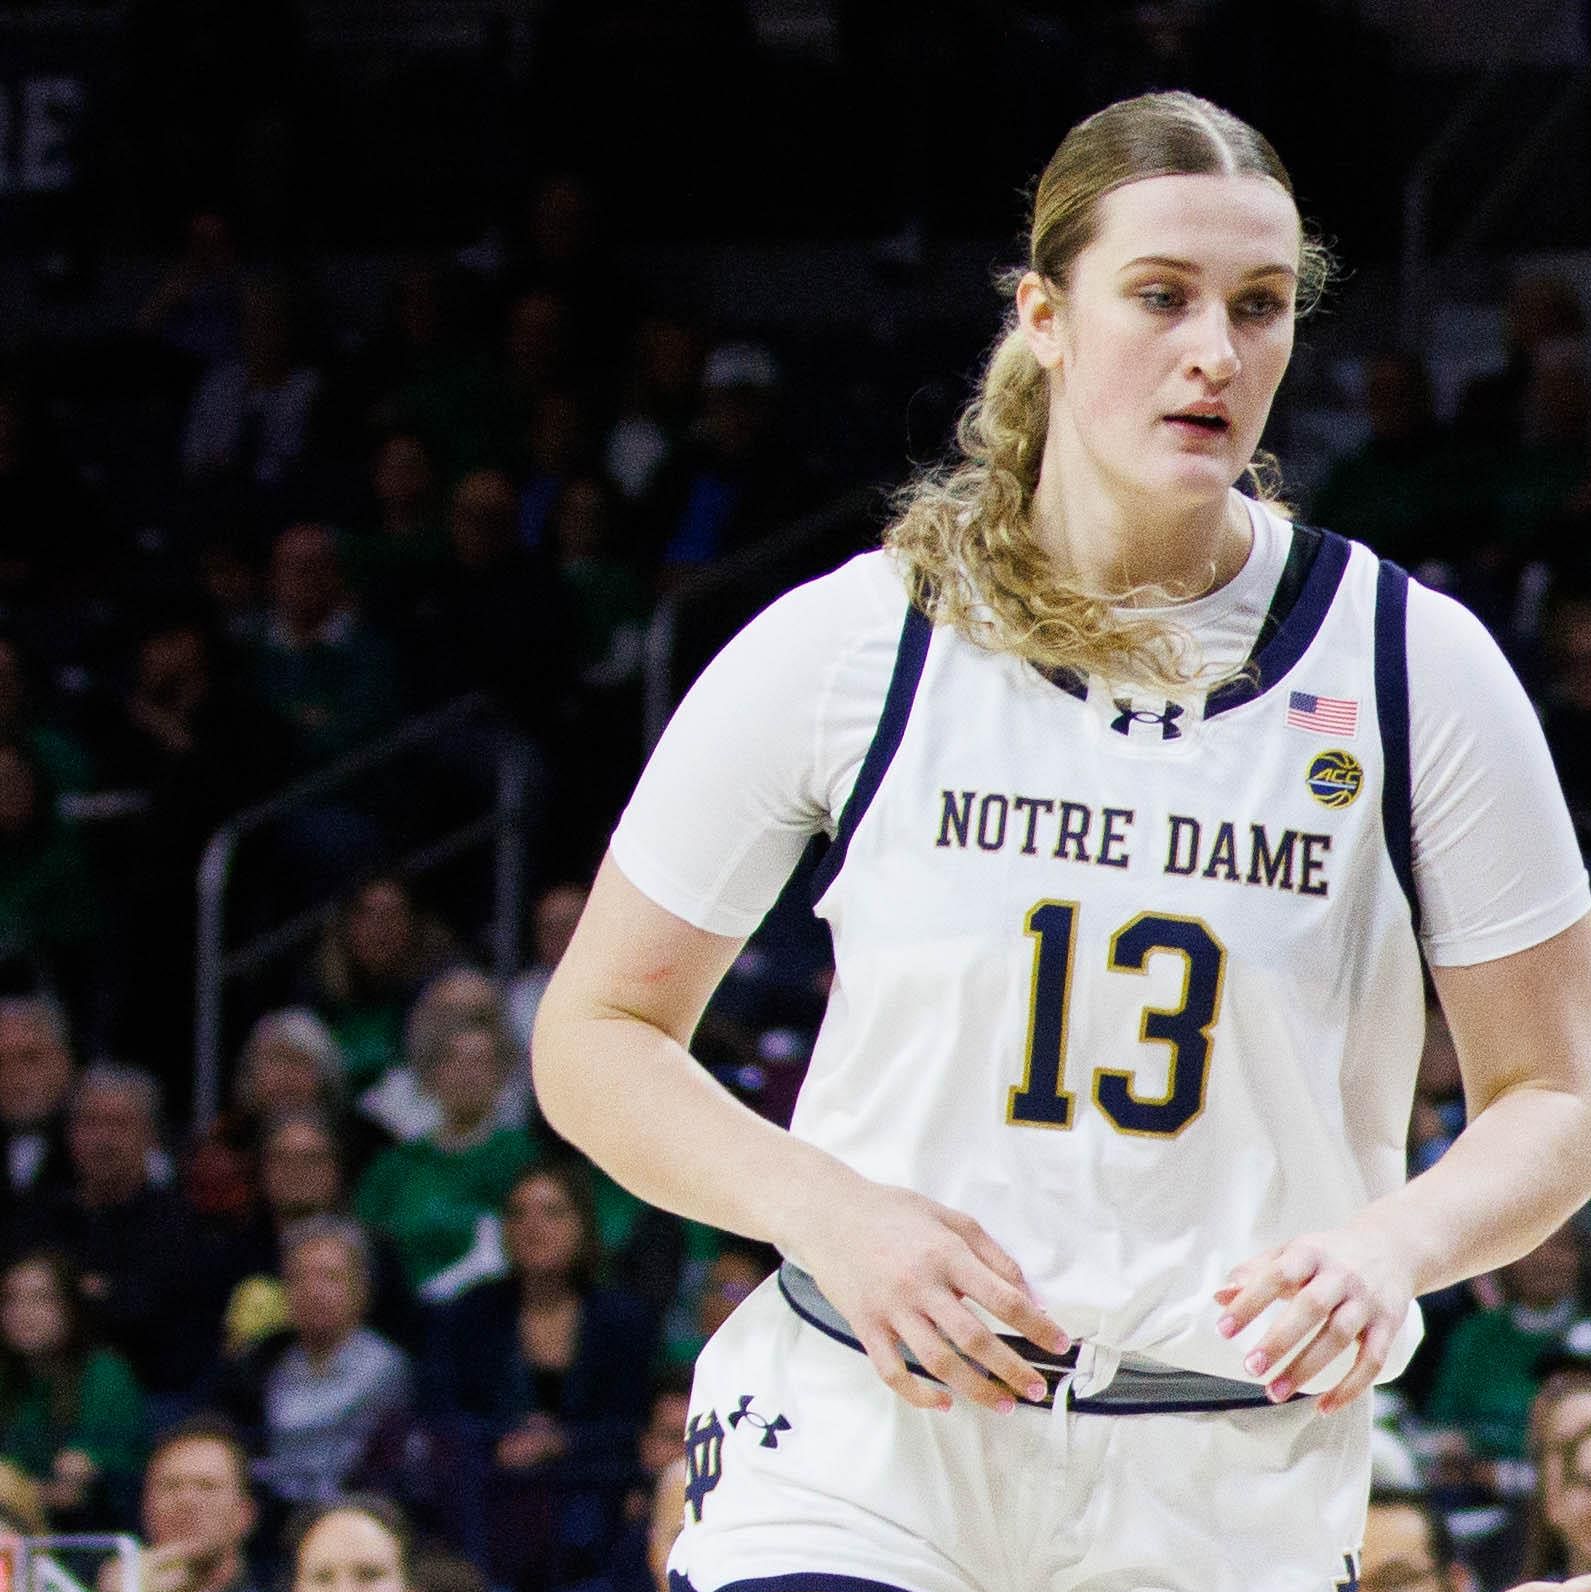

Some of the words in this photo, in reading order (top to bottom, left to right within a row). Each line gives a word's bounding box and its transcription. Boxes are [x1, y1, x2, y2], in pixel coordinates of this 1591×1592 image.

[935, 789, 1134, 870] NOTRE
[1163, 814, 1332, 898] DAME
[1005, 897, 1228, 1141] 13
